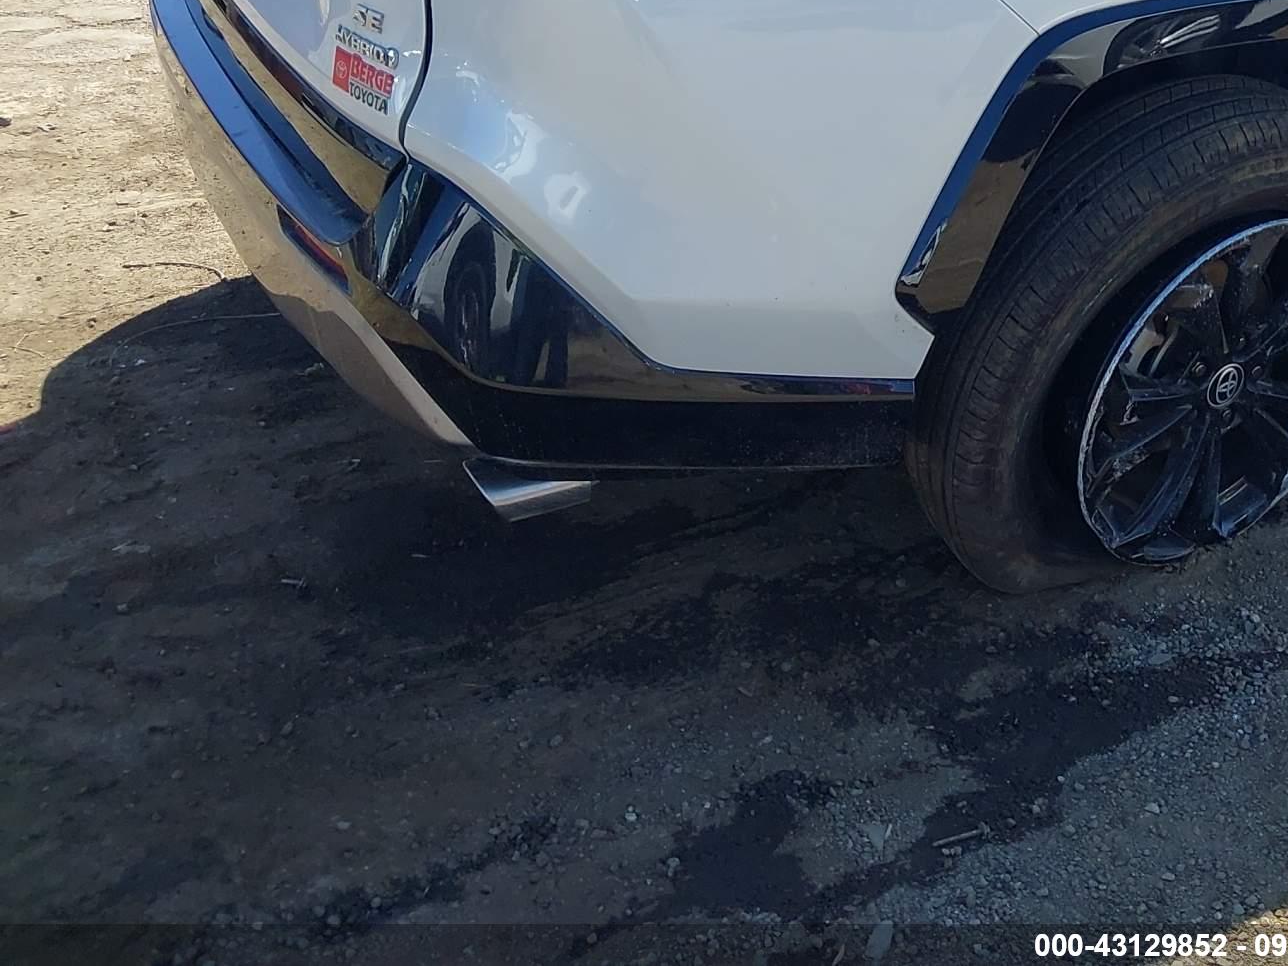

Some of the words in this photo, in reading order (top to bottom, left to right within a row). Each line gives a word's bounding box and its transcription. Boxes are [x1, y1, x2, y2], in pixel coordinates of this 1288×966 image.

[353, 3, 385, 35] SE
[335, 23, 389, 67] HYBRID
[350, 52, 395, 96] BERGE
[349, 81, 389, 115] TOYOTA
